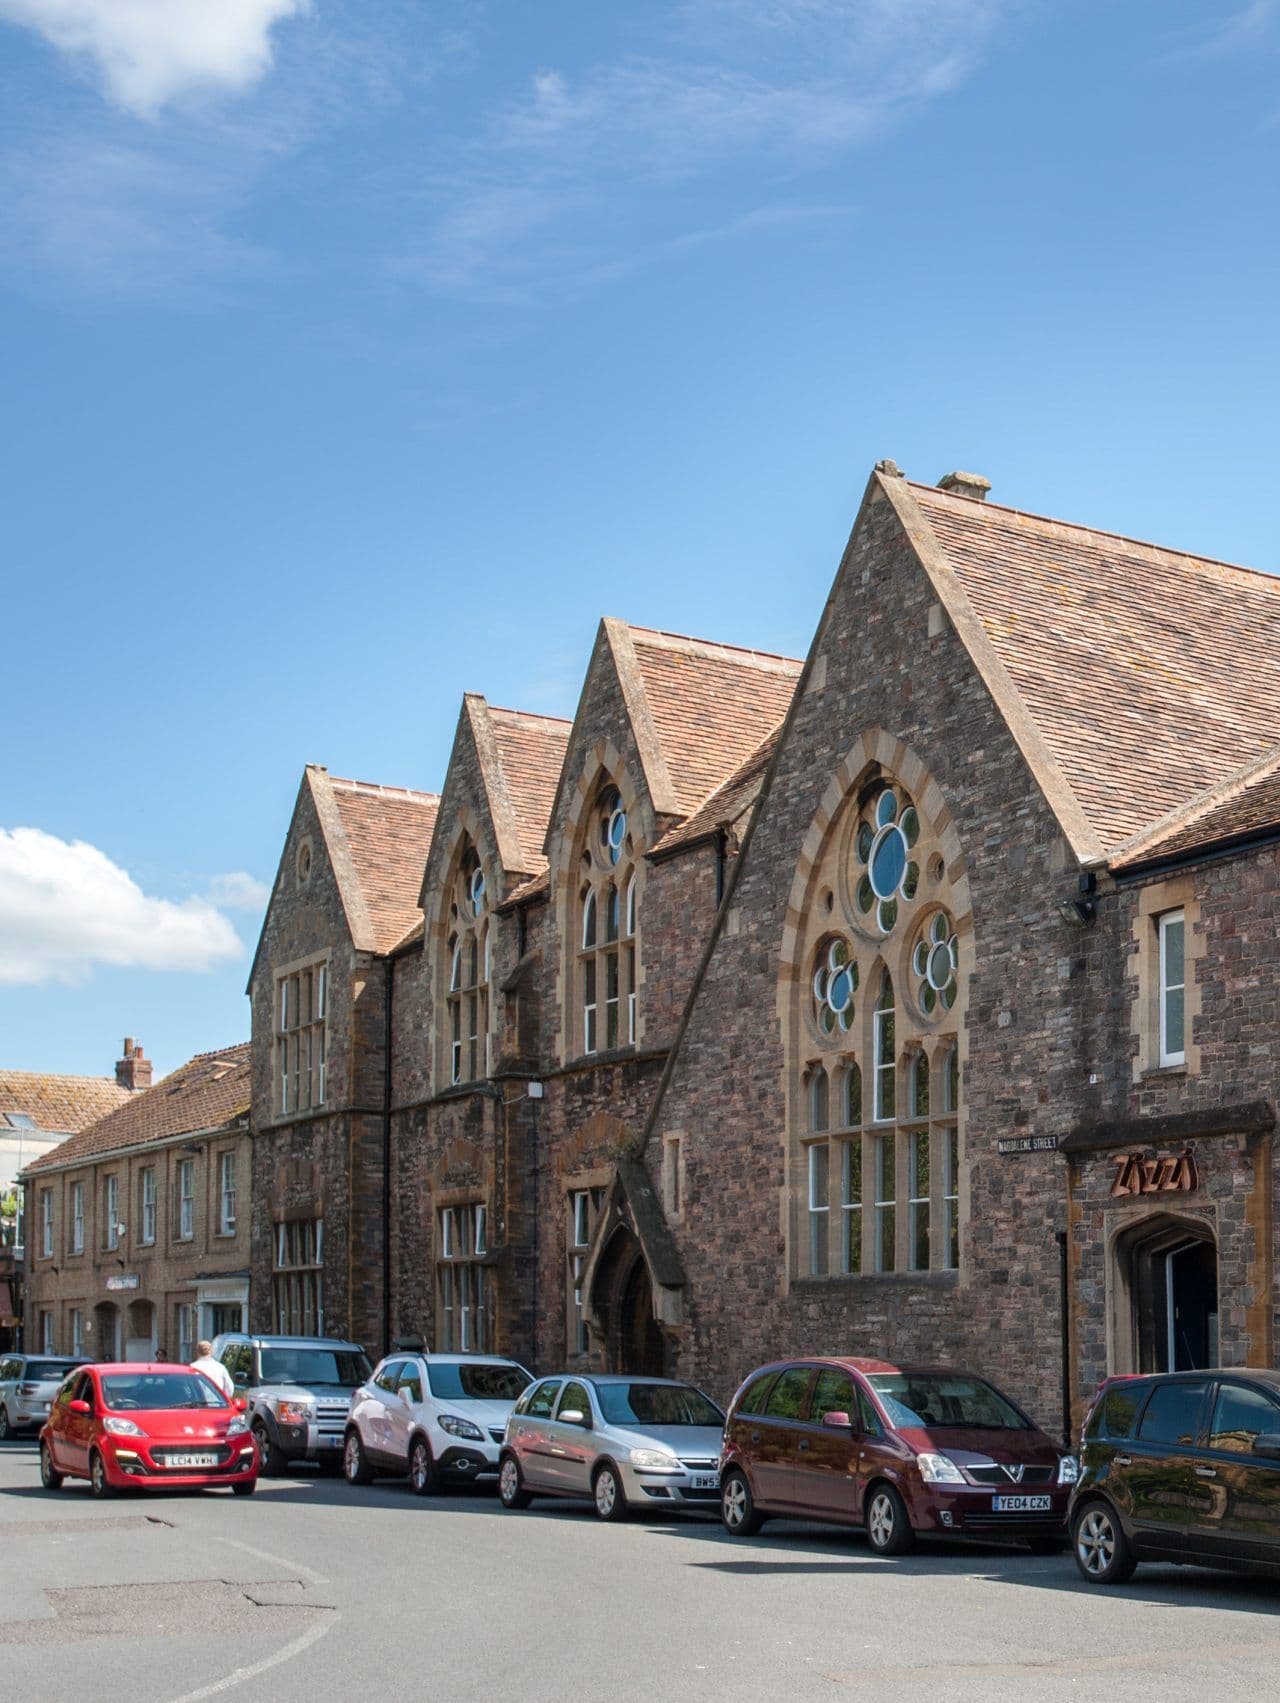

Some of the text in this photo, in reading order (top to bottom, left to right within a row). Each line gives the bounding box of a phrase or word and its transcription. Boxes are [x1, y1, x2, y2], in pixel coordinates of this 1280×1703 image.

[998, 1137, 1056, 1152] MAGDALENE STREET
[1108, 1147, 1198, 1197] Zizzi
[1000, 1497, 1049, 1509] YE04 CZK
